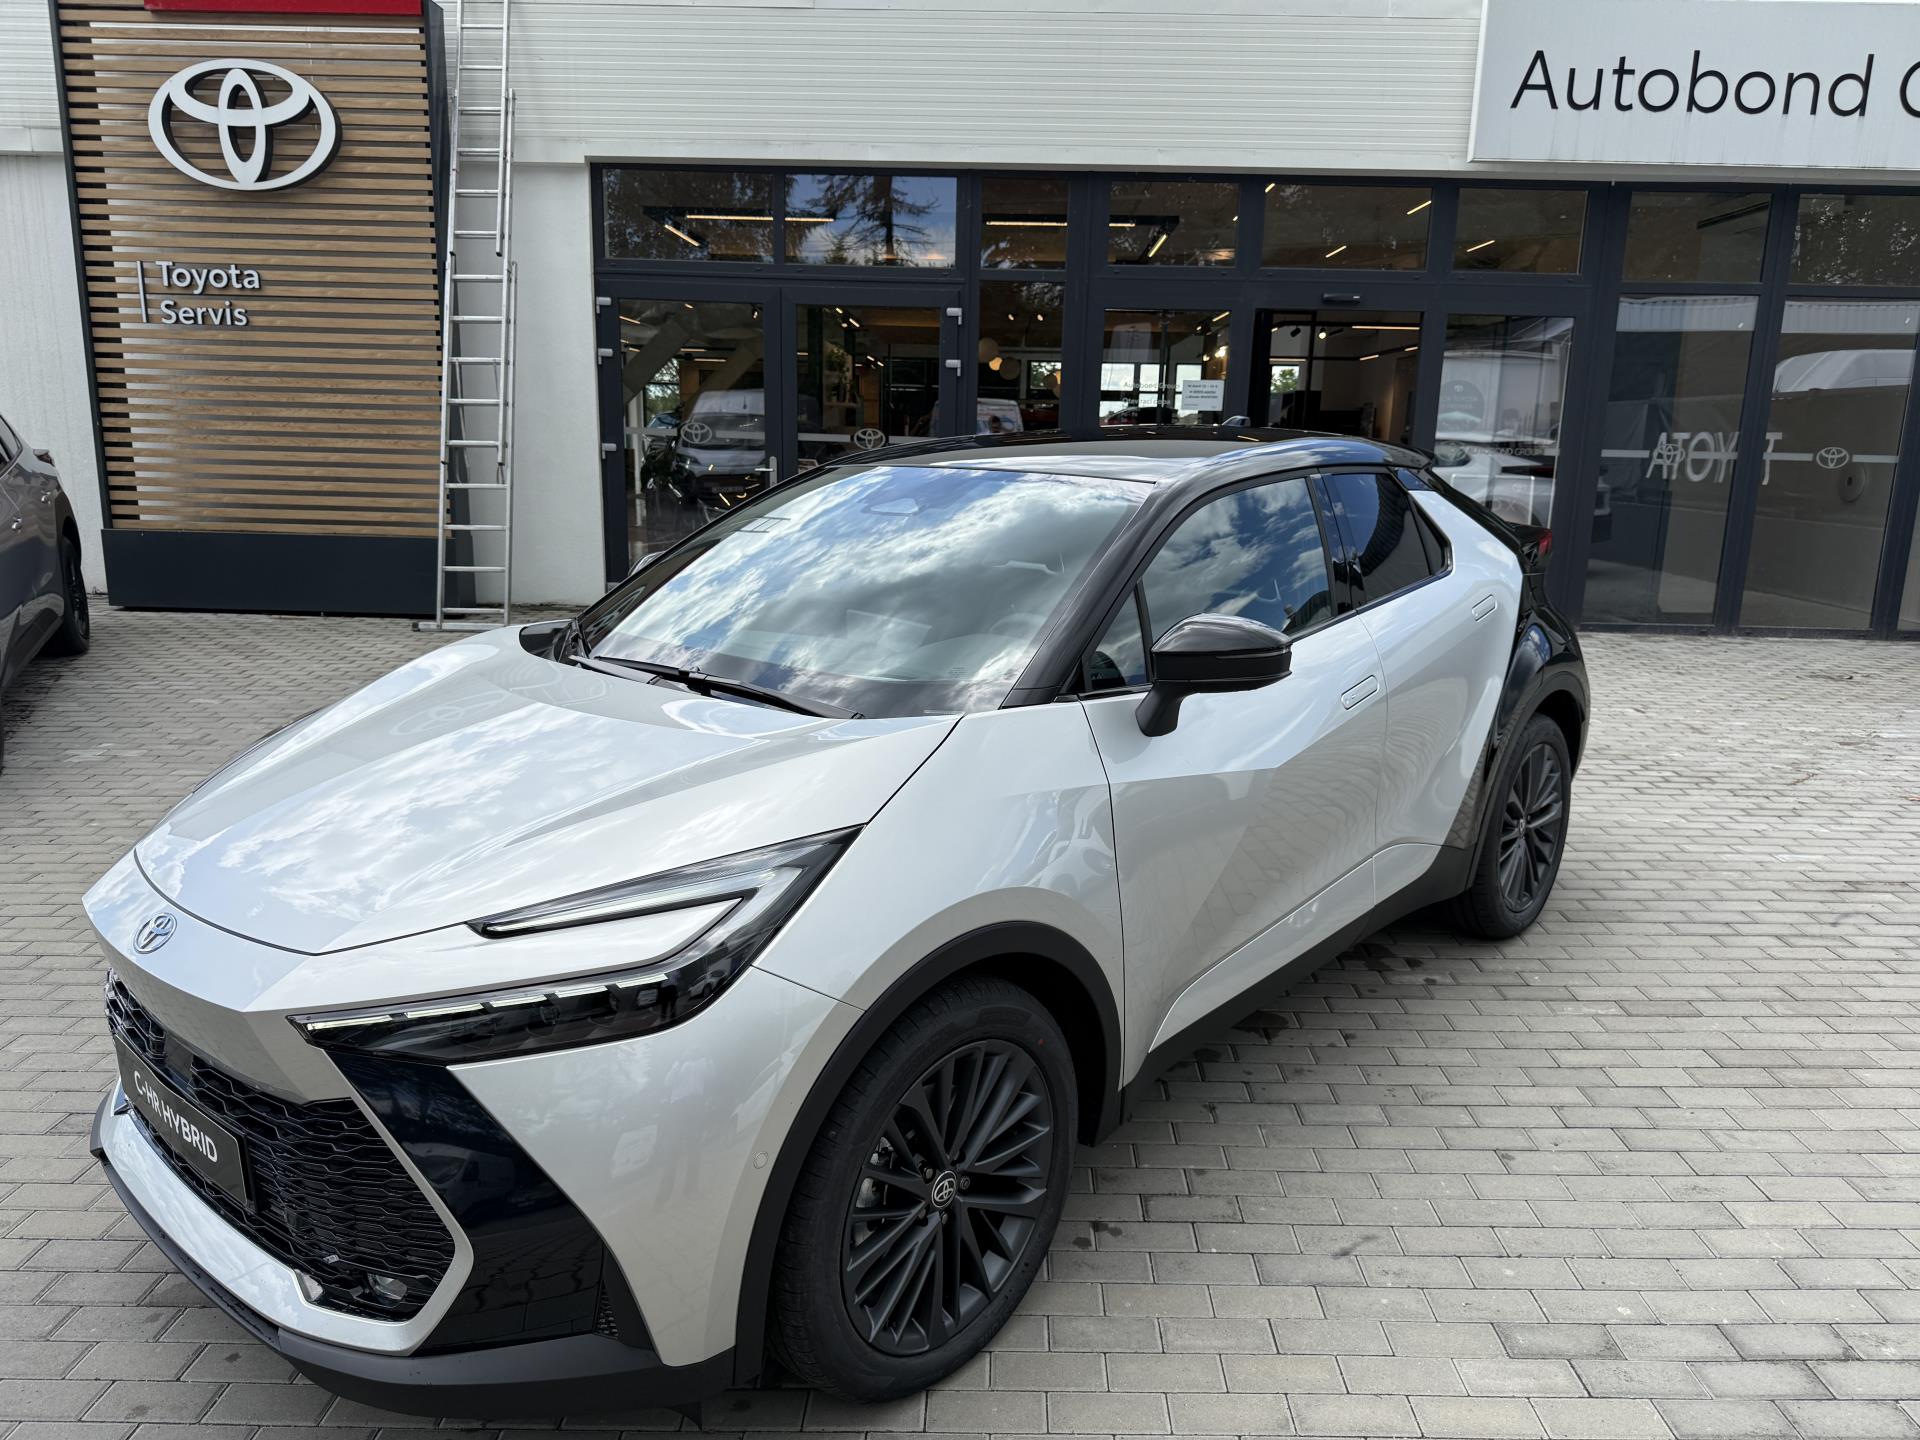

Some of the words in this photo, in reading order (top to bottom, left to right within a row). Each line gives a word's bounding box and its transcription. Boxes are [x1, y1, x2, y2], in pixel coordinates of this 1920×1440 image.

[1510, 49, 1875, 117] Autobond
[155, 260, 260, 295] Toyota
[160, 299, 249, 326] Servis
[134, 1070, 162, 1117] C-HR
[161, 1100, 218, 1163] HYBRID
